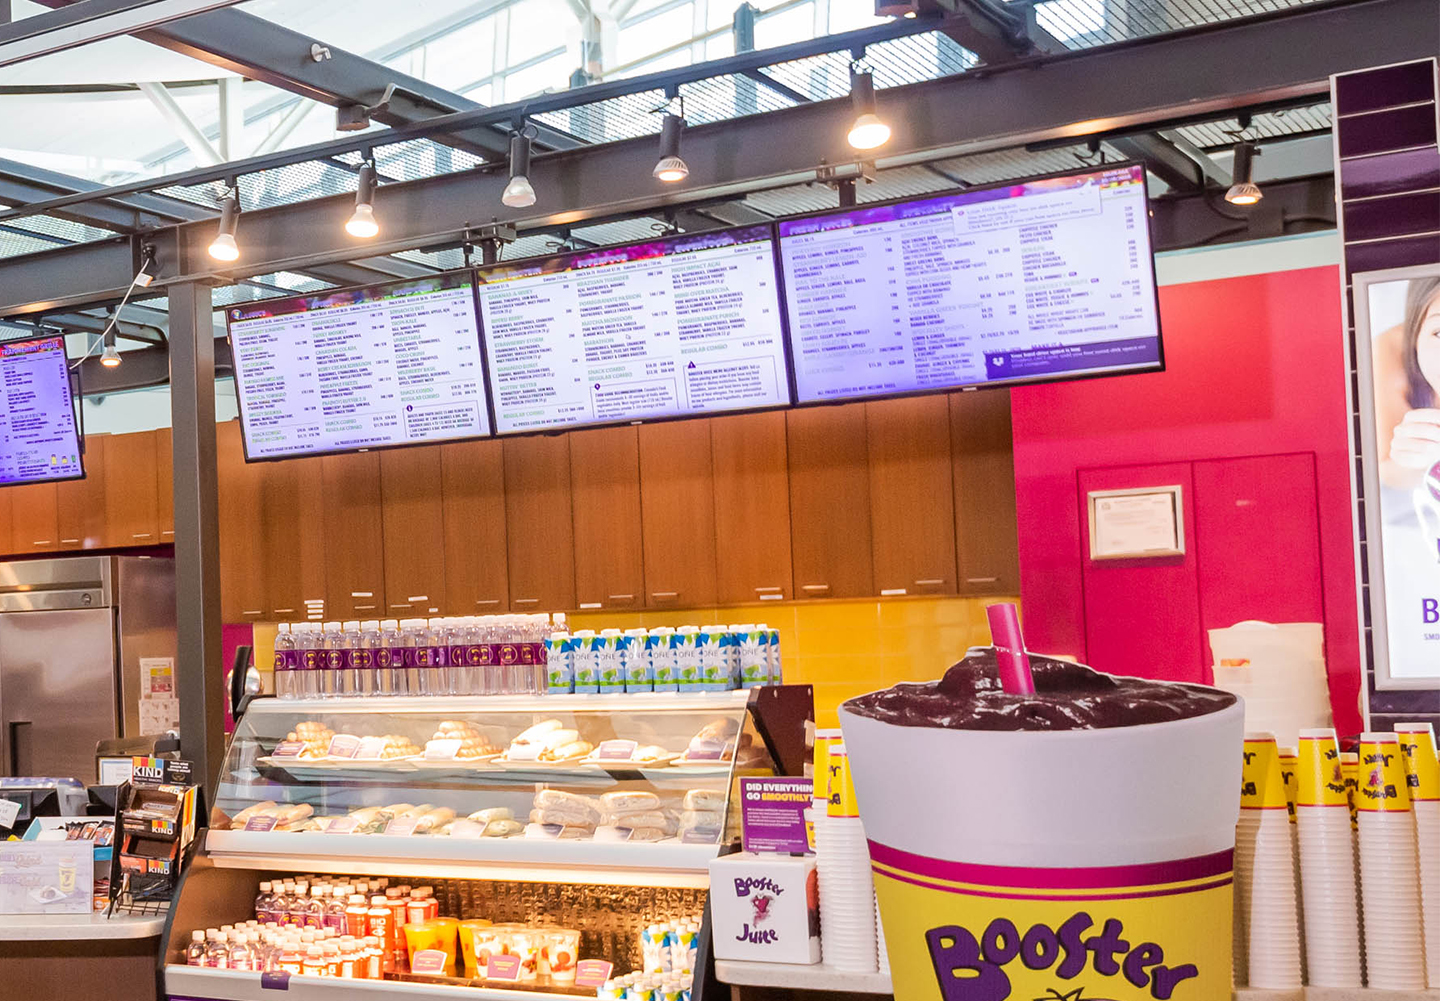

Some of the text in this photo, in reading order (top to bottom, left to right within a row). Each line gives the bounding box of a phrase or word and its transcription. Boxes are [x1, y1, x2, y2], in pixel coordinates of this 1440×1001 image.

[134, 767, 163, 777] KIND
[746, 783, 813, 792] DID EVERYTHIN
[746, 792, 760, 800] GO
[734, 877, 785, 897] Booster
[736, 924, 778, 944] Juice
[925, 911, 1199, 1001] Booster
